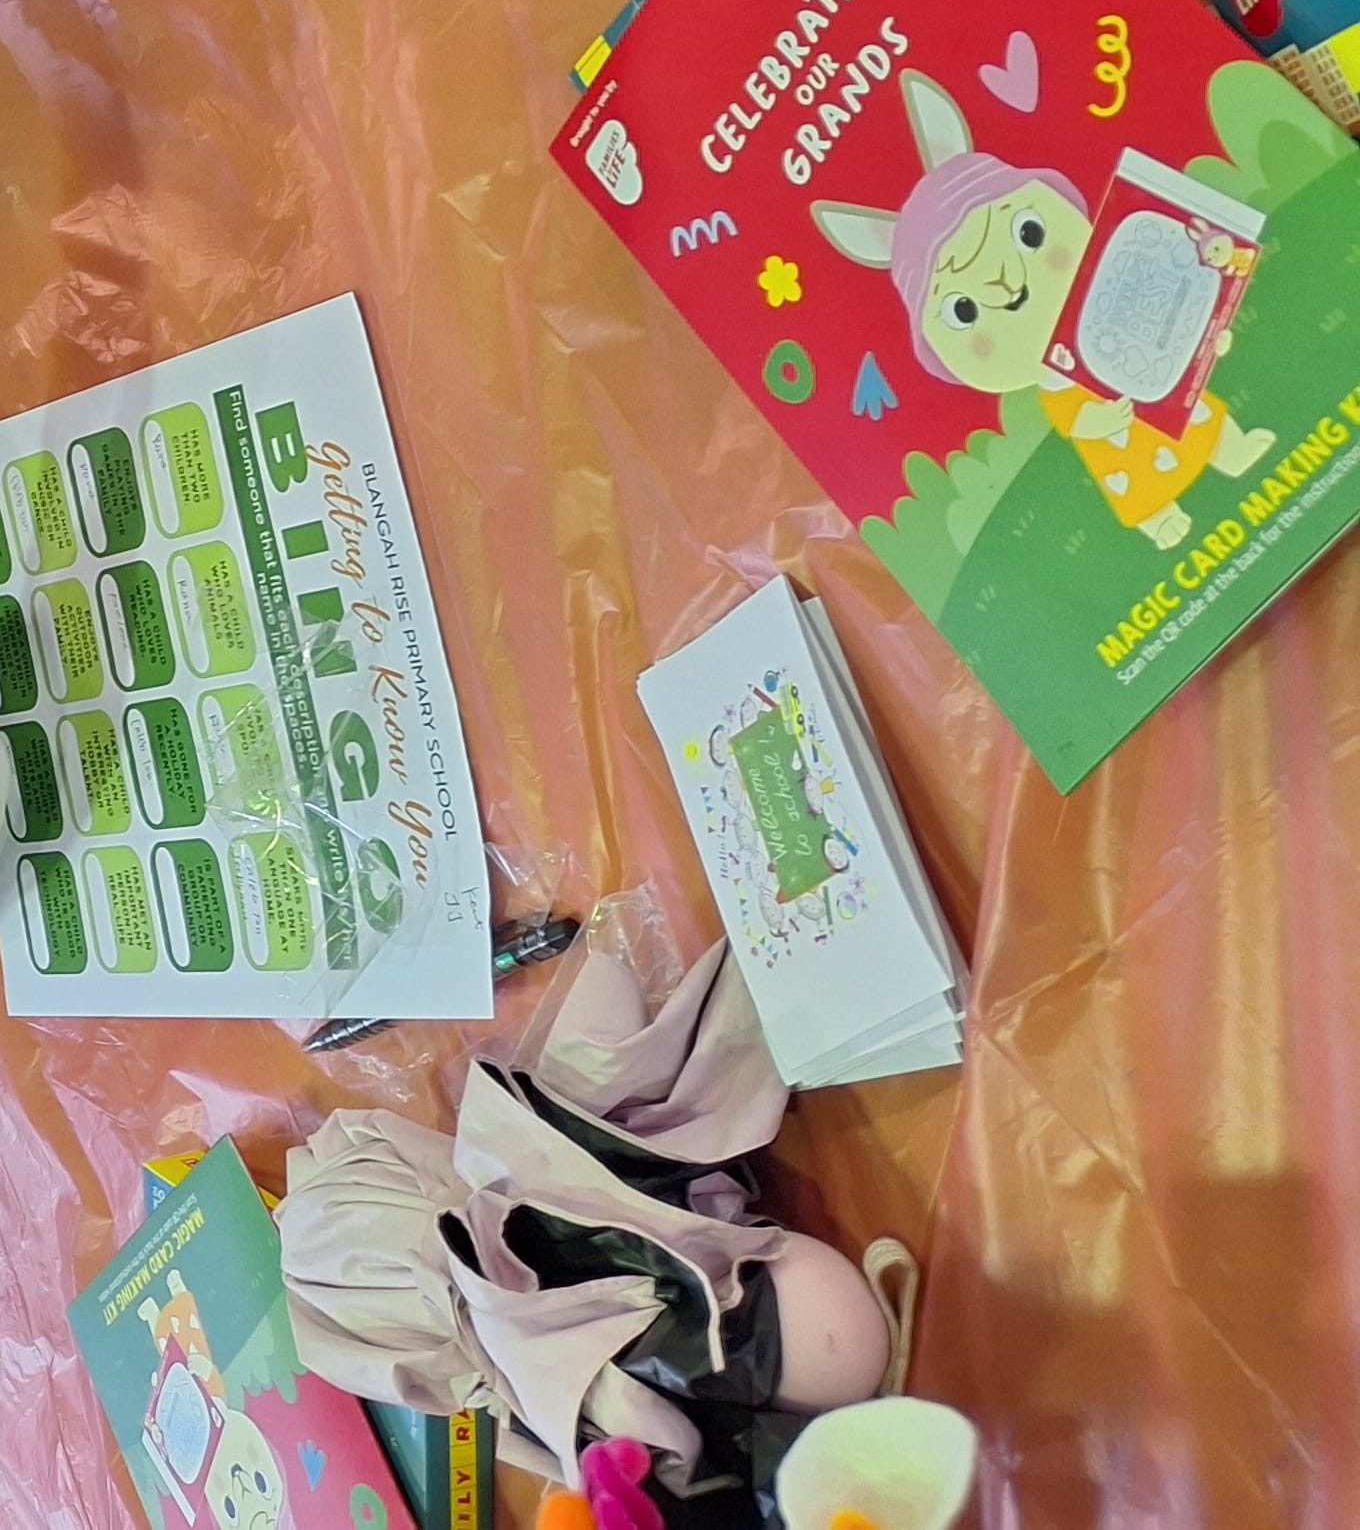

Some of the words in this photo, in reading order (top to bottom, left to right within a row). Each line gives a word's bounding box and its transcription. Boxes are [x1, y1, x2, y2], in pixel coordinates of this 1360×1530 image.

[773, 14, 915, 186] GRANDS
[791, 51, 840, 107] OUR
[227, 390, 247, 431] Find
[171, 434, 191, 505] CHILDREN.
[180, 432, 194, 469] THAN
[188, 473, 201, 504] TWO
[189, 429, 201, 456] HAS
[195, 462, 211, 501] MORE
[237, 437, 268, 525] someone
[258, 530, 278, 569] that
[304, 436, 380, 593] Getting
[1095, 579, 1181, 669] MAGIC
[1170, 514, 1248, 594] CARD
[1237, 412, 1351, 530] MAKING
[268, 574, 286, 603] fits
[350, 596, 395, 651] to
[1116, 654, 1146, 685] Scan
[1140, 636, 1166, 662] the
[1158, 620, 1182, 644] QR
[1176, 595, 1208, 628] code
[1201, 585, 1219, 603] at
[1213, 564, 1239, 590] the
[1232, 539, 1264, 572] back
[1258, 521, 1282, 545] for
[1277, 502, 1304, 530] the
[254, 400, 404, 933] BINGO
[275, 608, 298, 658] each
[361, 462, 399, 568] BLANGAH
[389, 575, 412, 622] RISE
[401, 628, 437, 733] PRIMARY
[424, 737, 458, 841] SCHOOL
[256, 572, 278, 625] name
[269, 630, 284, 648] in
[280, 693, 309, 770] spaces.
[365, 659, 426, 786] Know
[749, 766, 788, 862] Welcome
[764, 752, 800, 821] school
[323, 829, 347, 882] write
[387, 794, 446, 891] You
[792, 833, 812, 856] to
[147, 1239, 174, 1274] CARD
[171, 1206, 203, 1251] MAGIC
[102, 1300, 119, 1326] KIT
[114, 1264, 150, 1310] MAKING
